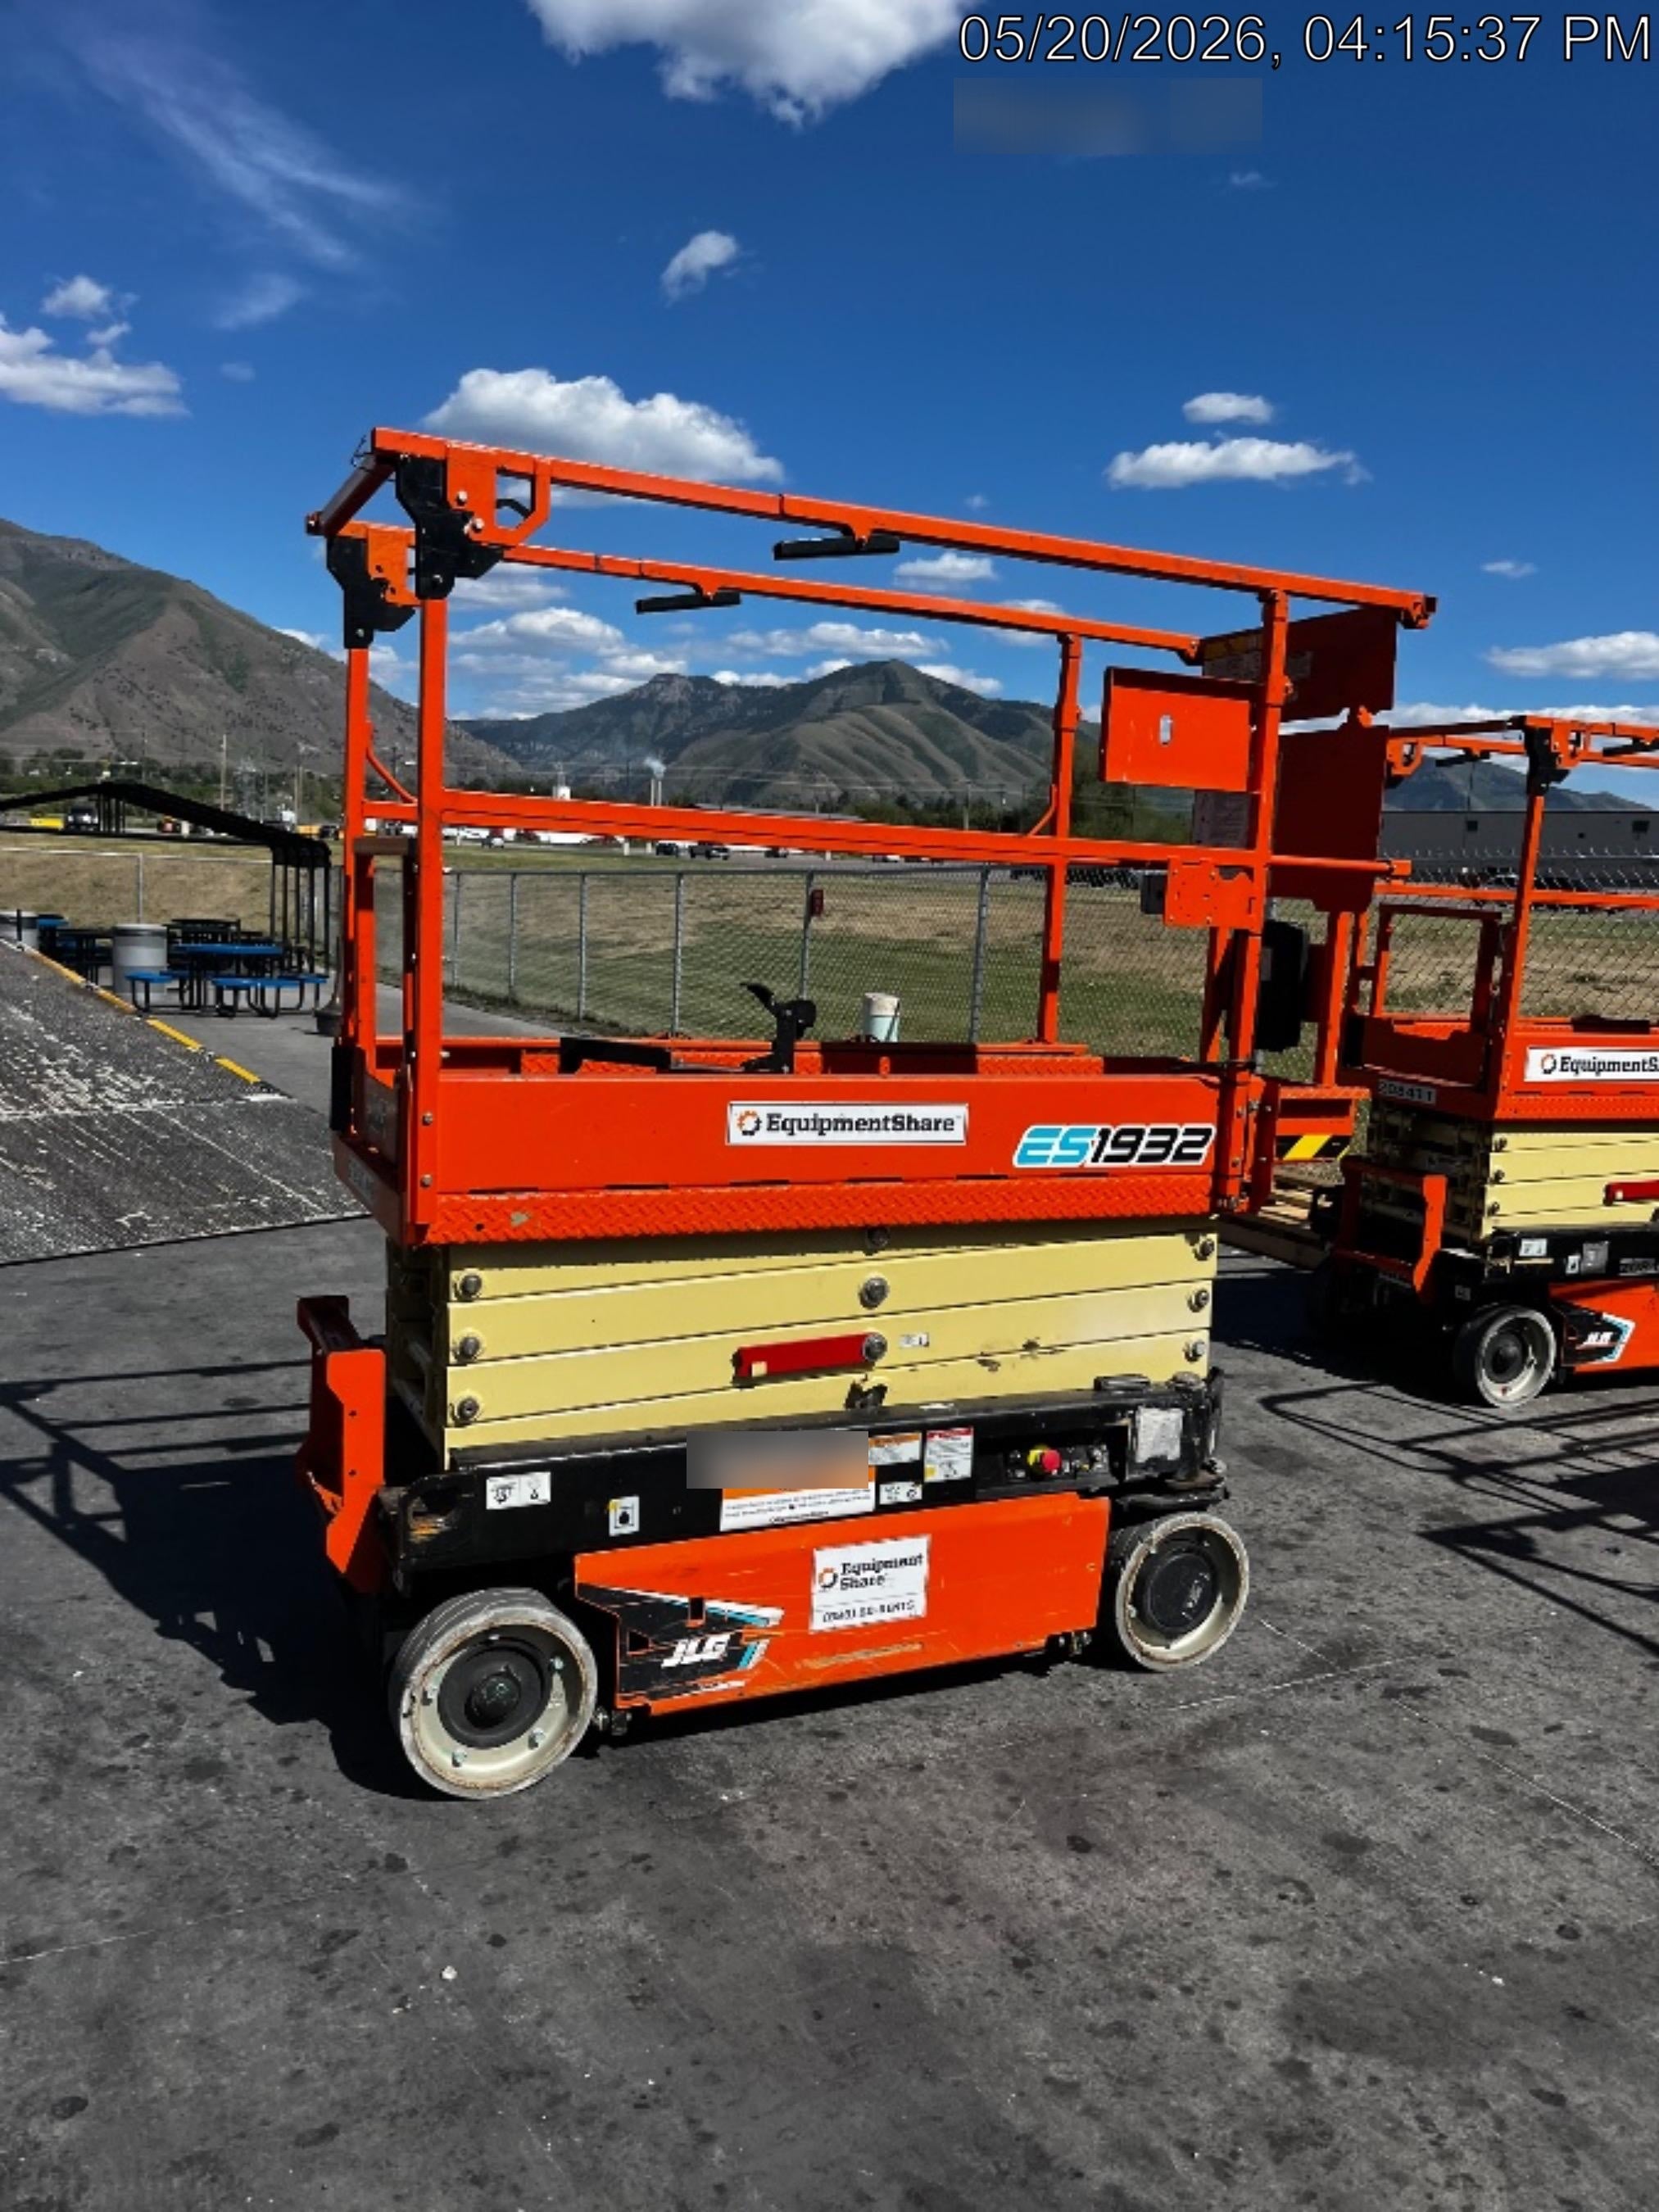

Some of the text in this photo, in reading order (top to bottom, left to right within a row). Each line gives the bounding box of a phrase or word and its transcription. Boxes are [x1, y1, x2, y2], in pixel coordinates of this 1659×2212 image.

[1559, 1056, 1659, 1077] EquipmentS
[766, 1113, 955, 1136] EquipmentShare
[1014, 1125, 1215, 1166] ES1932
[841, 1553, 923, 1575] Equipment
[840, 1575, 886, 1591] Share
[660, 1633, 731, 1668] JLG
